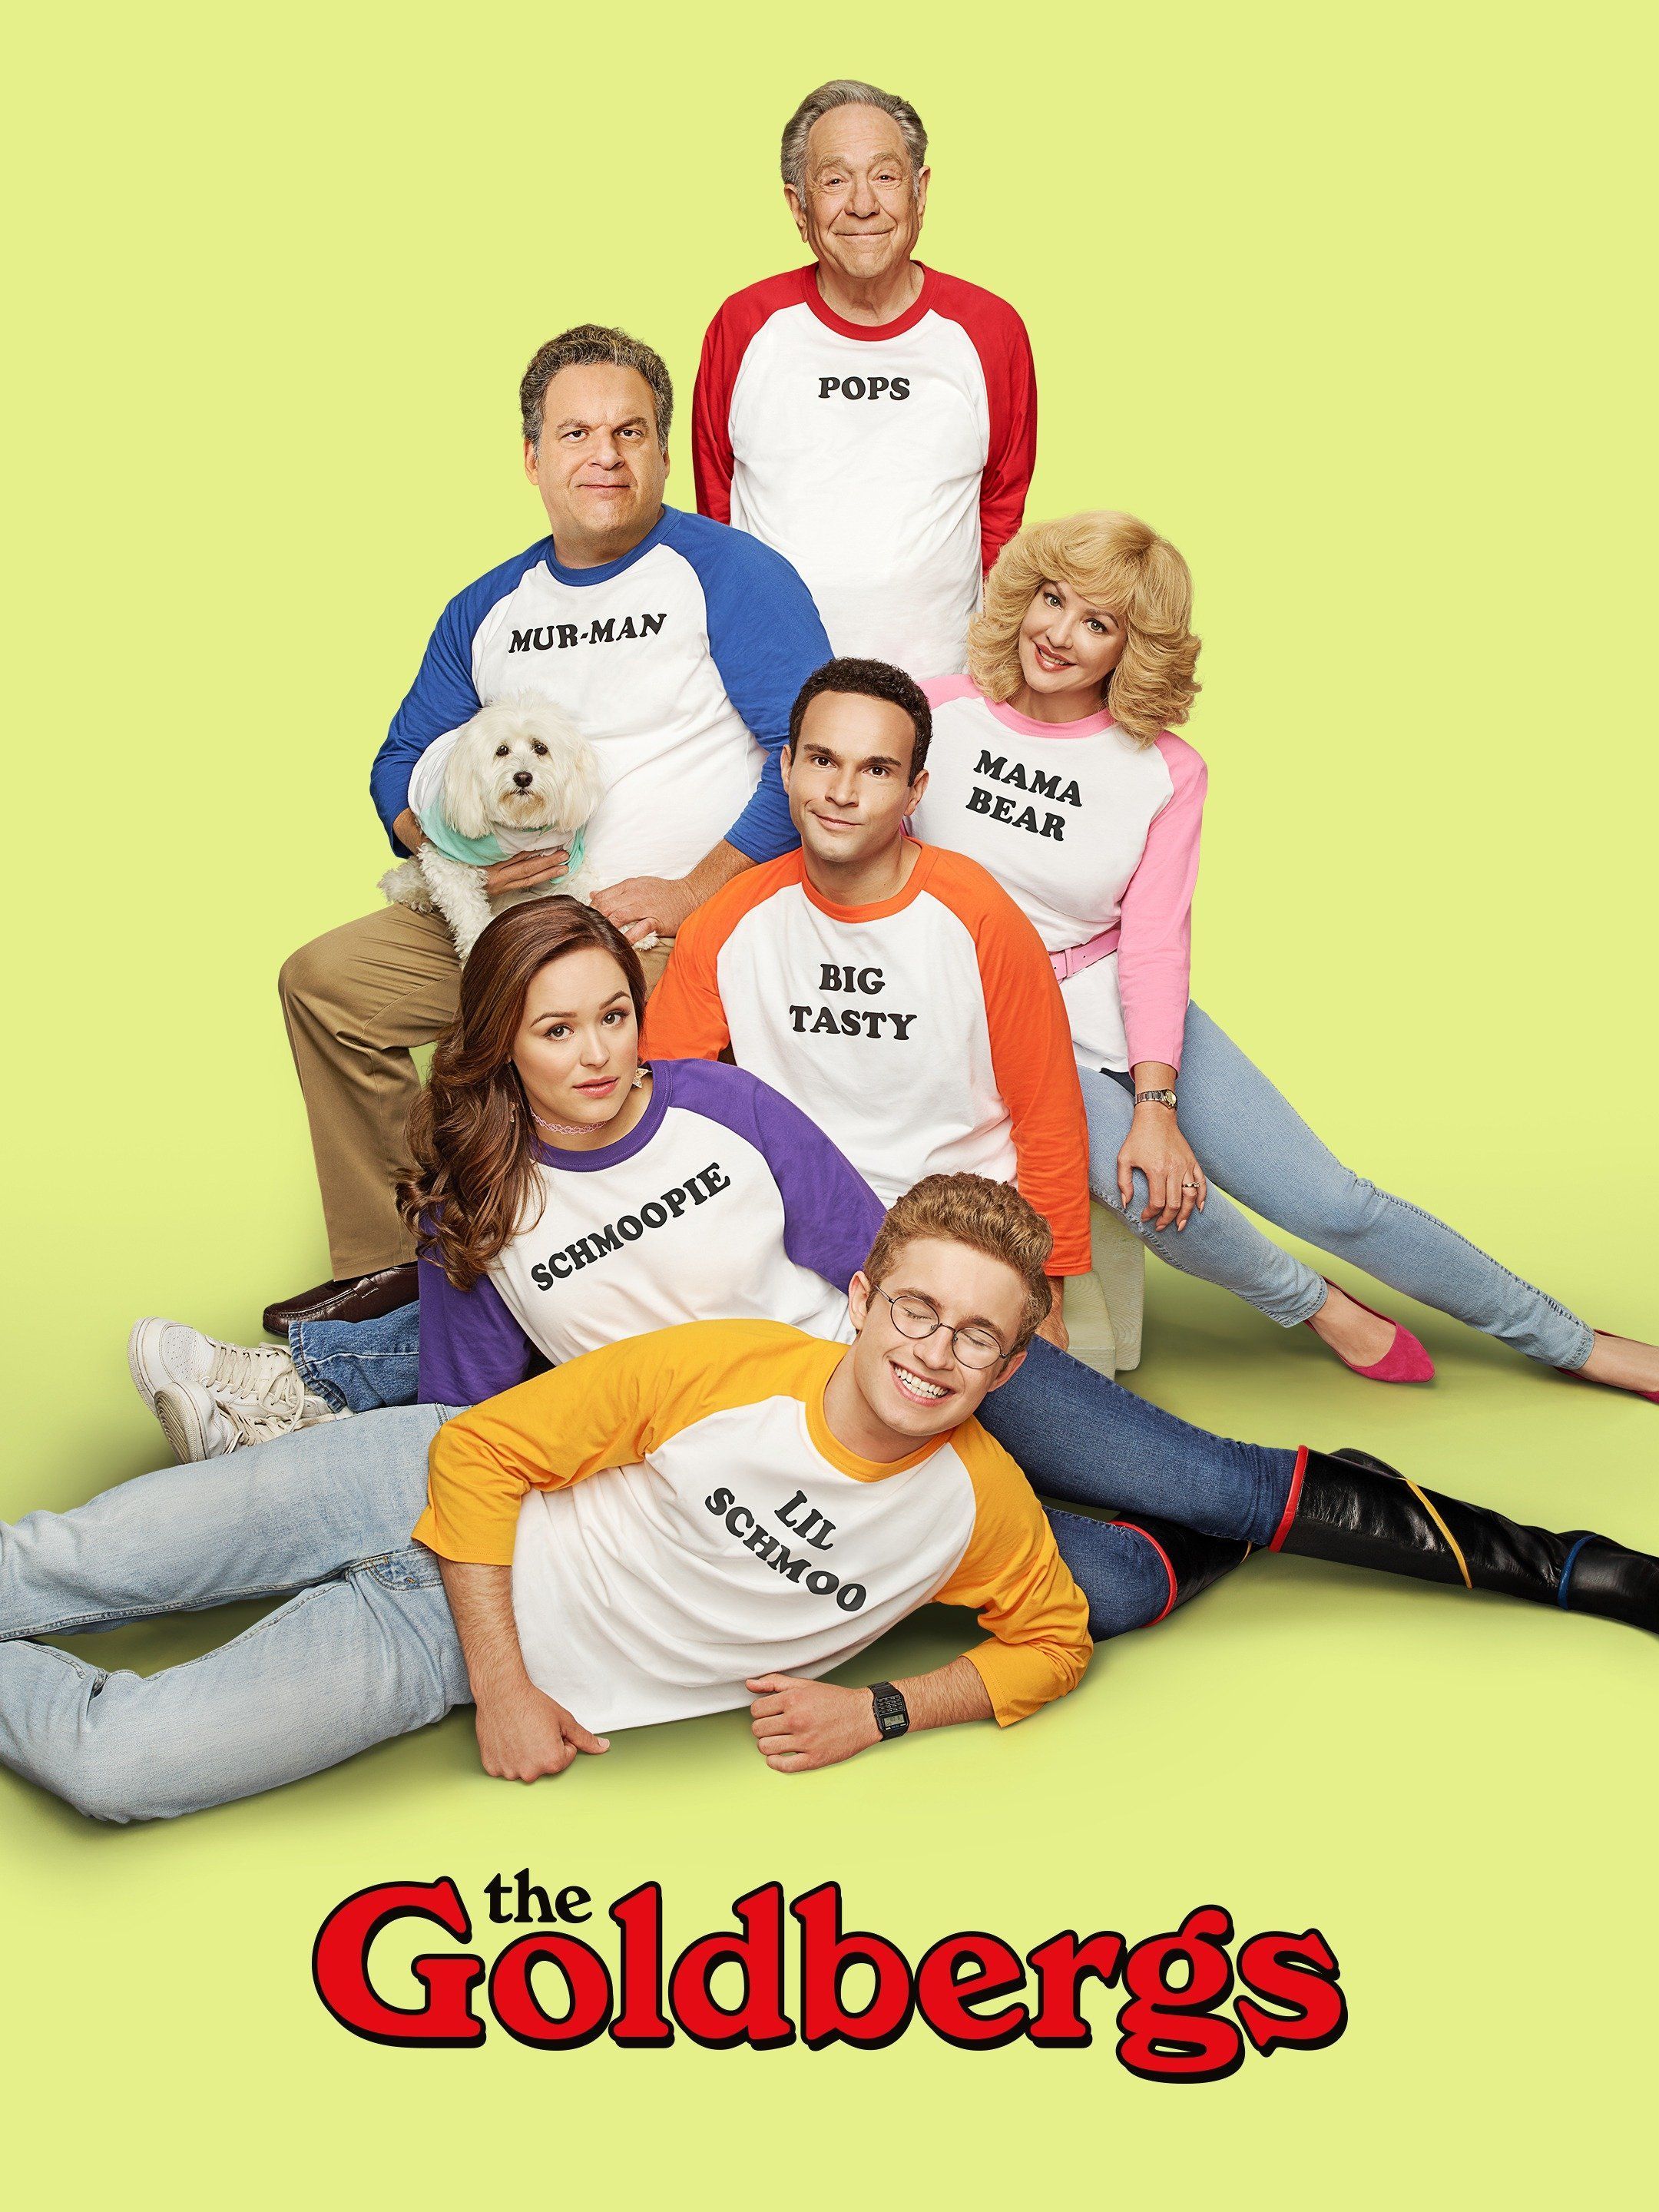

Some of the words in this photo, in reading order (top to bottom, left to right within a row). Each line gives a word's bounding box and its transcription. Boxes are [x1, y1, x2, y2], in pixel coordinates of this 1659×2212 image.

[818, 376, 910, 401] POPS
[508, 613, 667, 654] MUR-MAN
[972, 749, 1083, 807] MAMA
[965, 786, 1066, 842] BEAR
[818, 963, 886, 995] BIG
[789, 1005, 918, 1041] TASTY
[531, 1162, 731, 1292] SCHMOOPIE
[773, 1489, 836, 1551] LIL
[704, 1487, 867, 1612] SCHMOO
